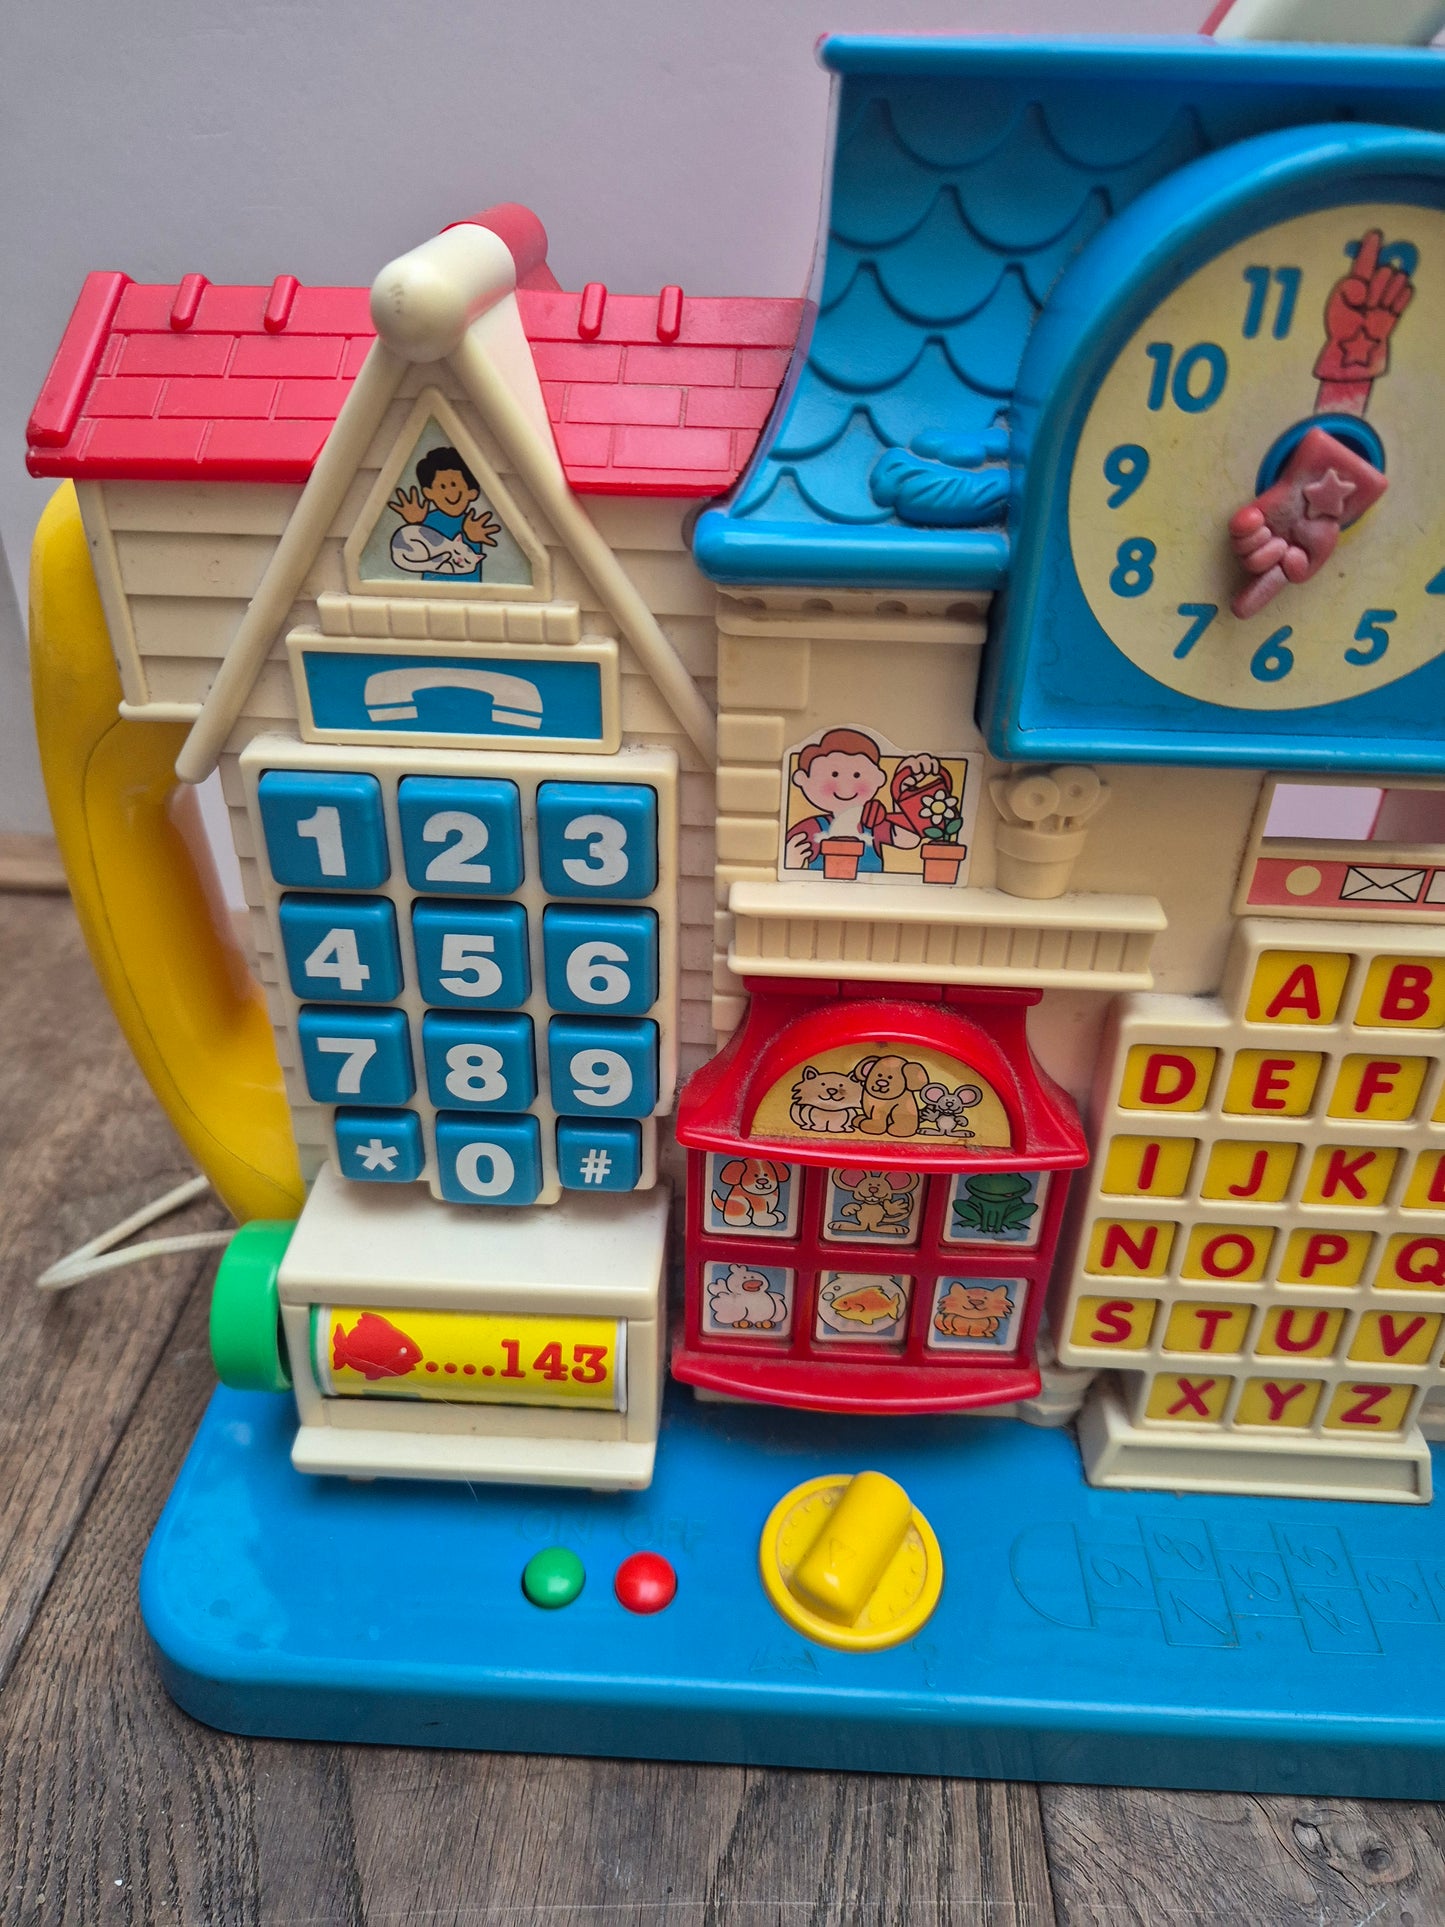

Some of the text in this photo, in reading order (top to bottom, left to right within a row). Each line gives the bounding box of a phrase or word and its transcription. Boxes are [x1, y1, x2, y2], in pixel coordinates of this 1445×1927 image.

[1243, 266, 1301, 340] 11
[1146, 342, 1228, 414] 10
[1103, 443, 1150, 510] 9
[1109, 536, 1156, 599] 8
[1173, 602, 1217, 660] 7
[1249, 625, 1294, 683] 6
[1343, 608, 1396, 667] 5
[298, 806, 628, 885] 1 2 3
[305, 929, 630, 1004] 4 5 6
[1266, 964, 1432, 1020] A B
[318, 1038, 632, 1106] 7 8 9
[1140, 1054, 1402, 1112] D E F
[456, 1143, 514, 1196] 0
[580, 1150, 611, 1183] #
[1138, 1143, 1160, 1189] I
[1229, 1150, 1268, 1196] J
[1322, 1149, 1376, 1199] K
[1101, 1224, 1445, 1286] N O P Q
[1092, 1301, 1426, 1356] S T U V
[1168, 1378, 1392, 1424] X Y Z
[520, 1511, 594, 1546] ON
